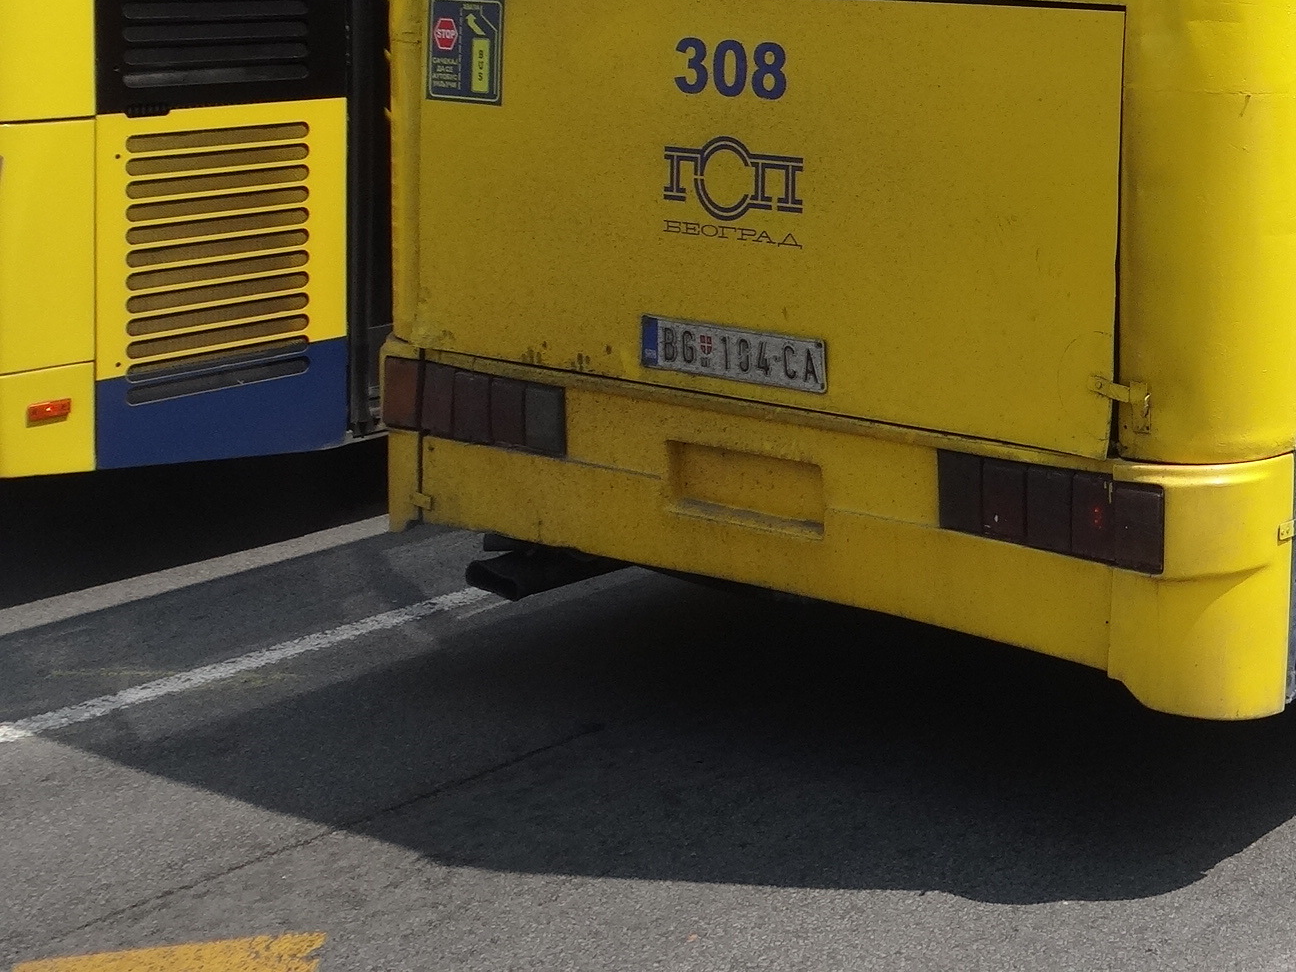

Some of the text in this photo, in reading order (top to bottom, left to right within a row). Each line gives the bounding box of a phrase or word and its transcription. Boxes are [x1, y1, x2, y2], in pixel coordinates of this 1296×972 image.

[436, 30, 455, 39] STOP
[674, 37, 787, 101] 308
[663, 135, 804, 222] ГСП
[663, 219, 803, 250] БЕОГРАД
